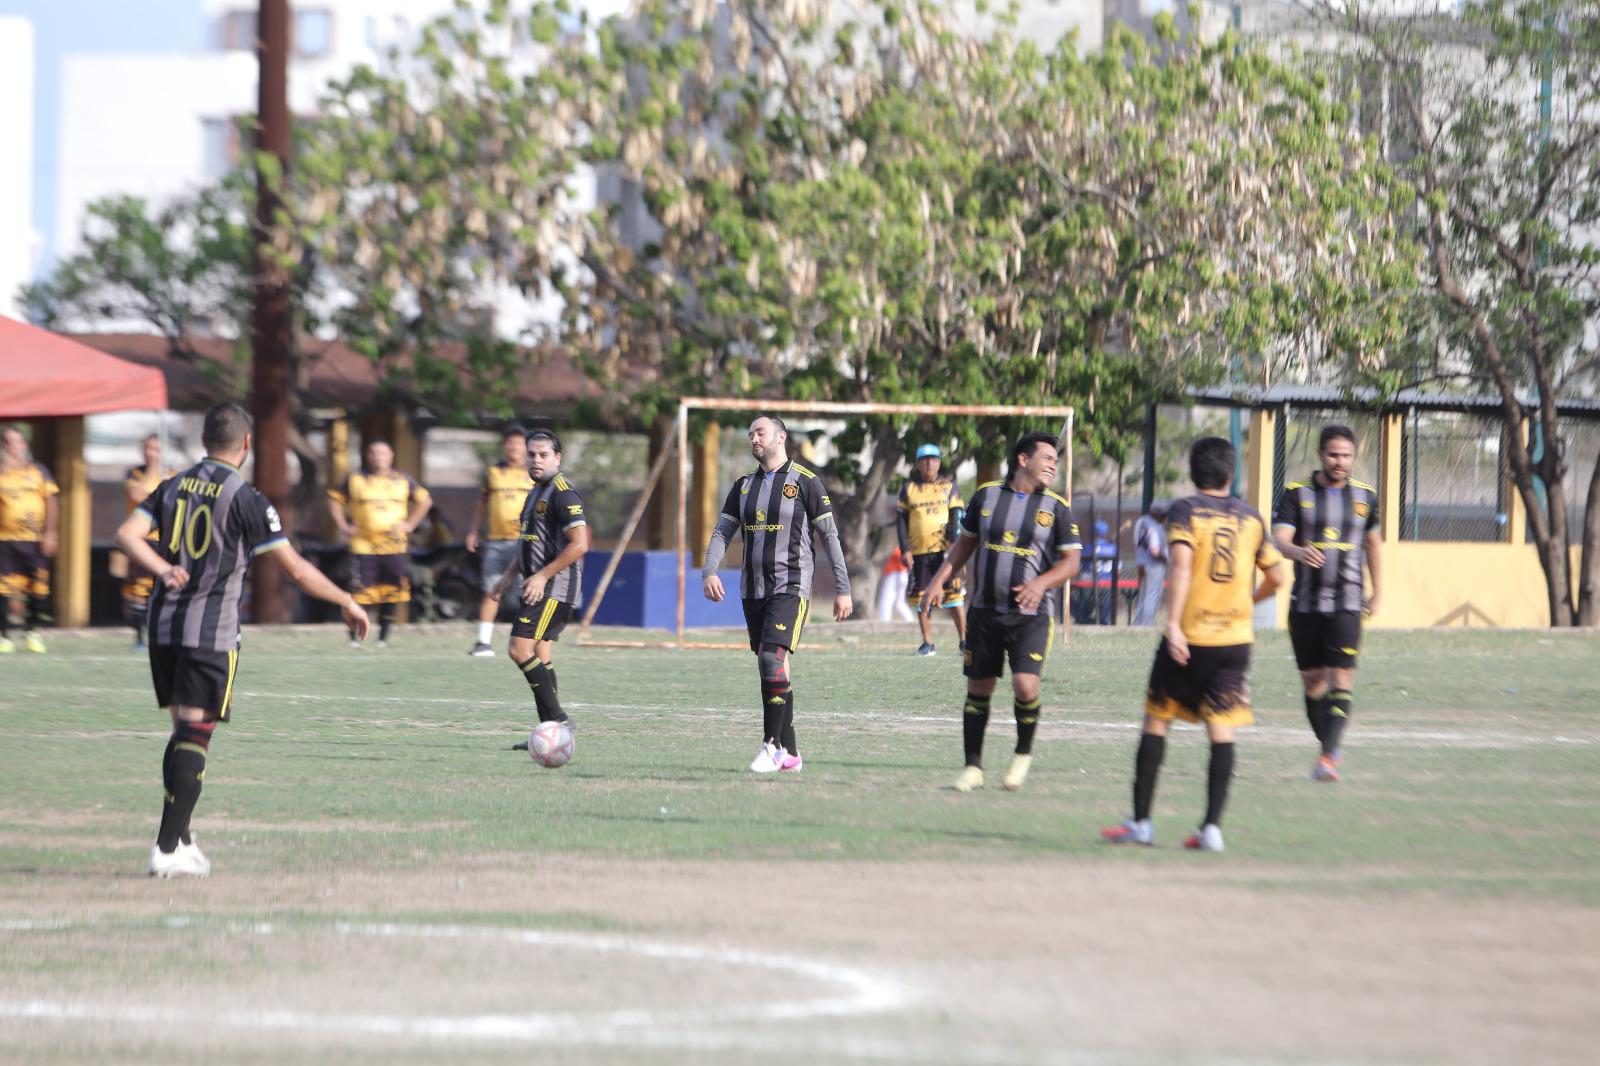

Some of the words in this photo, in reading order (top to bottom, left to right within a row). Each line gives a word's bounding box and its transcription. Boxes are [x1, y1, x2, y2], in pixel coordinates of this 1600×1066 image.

[179, 477, 223, 498] NUTRI
[169, 499, 212, 560] 10
[1210, 527, 1236, 583] 8
